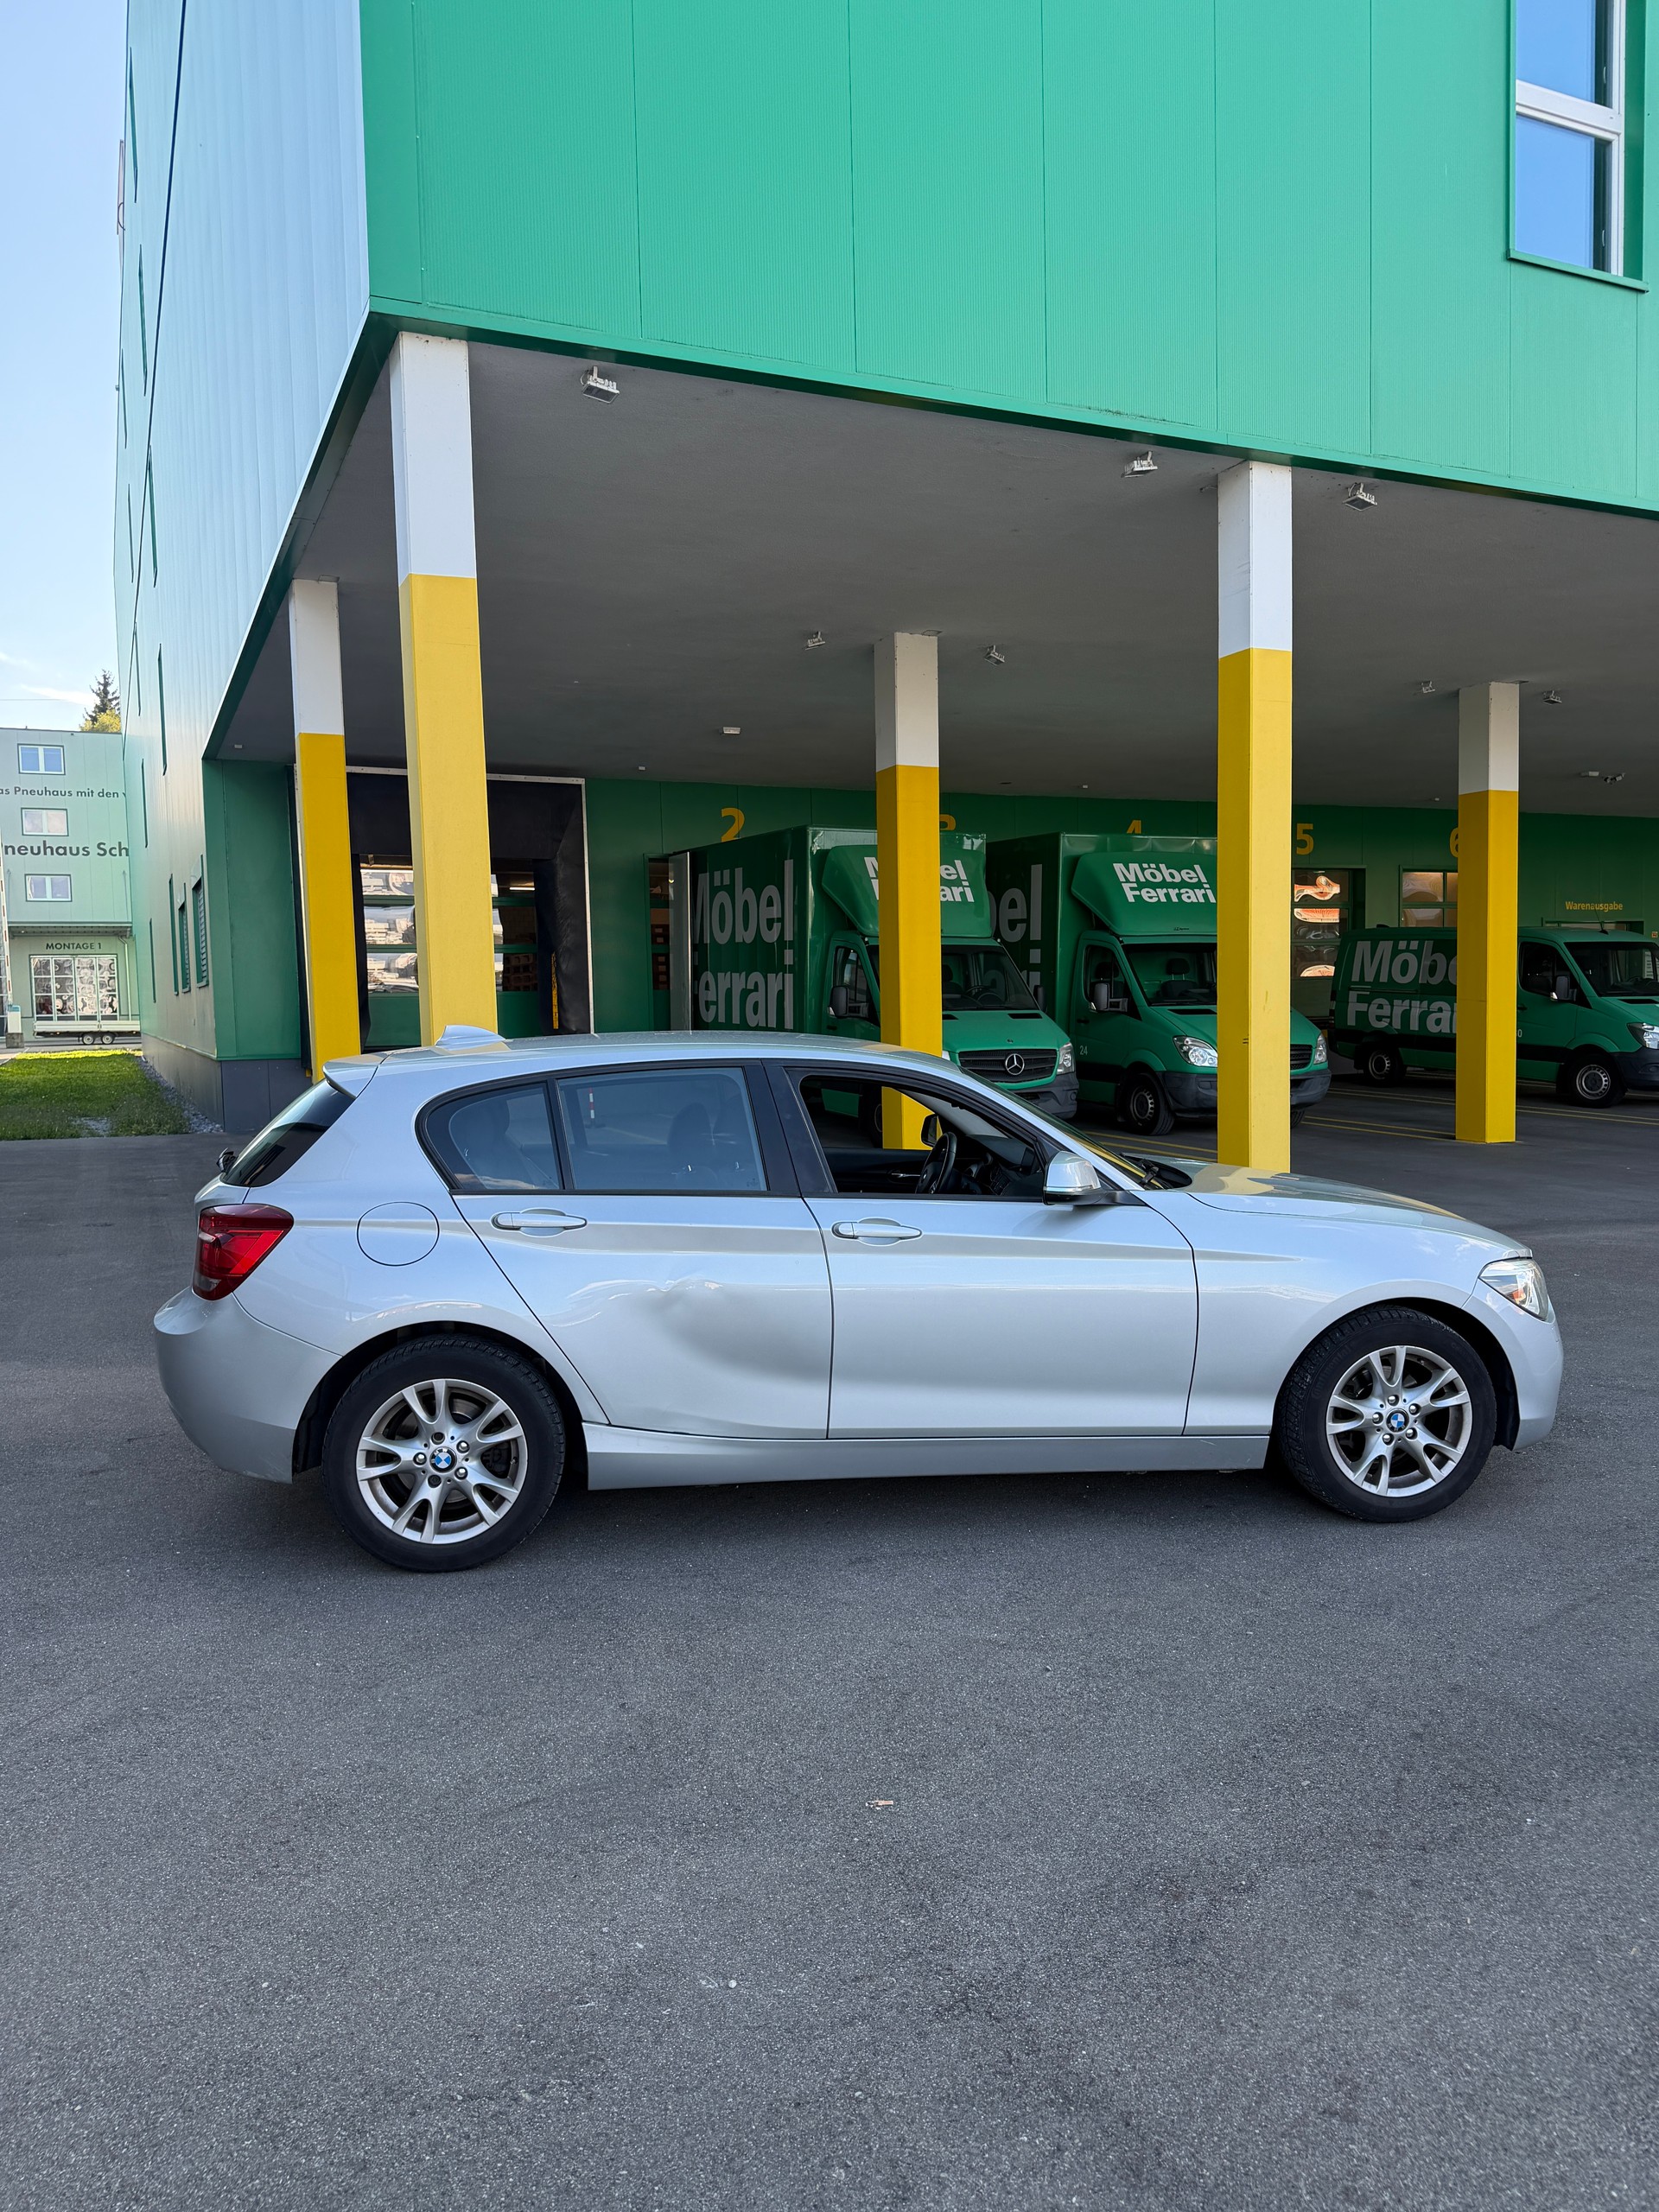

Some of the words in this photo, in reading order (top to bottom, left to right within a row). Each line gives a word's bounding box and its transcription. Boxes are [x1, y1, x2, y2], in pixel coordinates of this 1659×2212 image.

[14, 786, 73, 797] Pneuhaus
[76, 788, 94, 798] mit
[98, 788, 119, 798] den
[721, 807, 745, 842] 2
[3, 840, 91, 856] neuhaus
[1296, 823, 1314, 855] 5
[1113, 863, 1208, 882] Möbel
[1121, 882, 1217, 903] Ferrari
[1565, 901, 1623, 912] Warenausgabe
[1351, 940, 1457, 984] Möb
[694, 949, 794, 1030] errari
[1347, 990, 1457, 1033] Ferra
[1517, 1028, 1523, 1038] 0
[1079, 1045, 1088, 1056] 24
